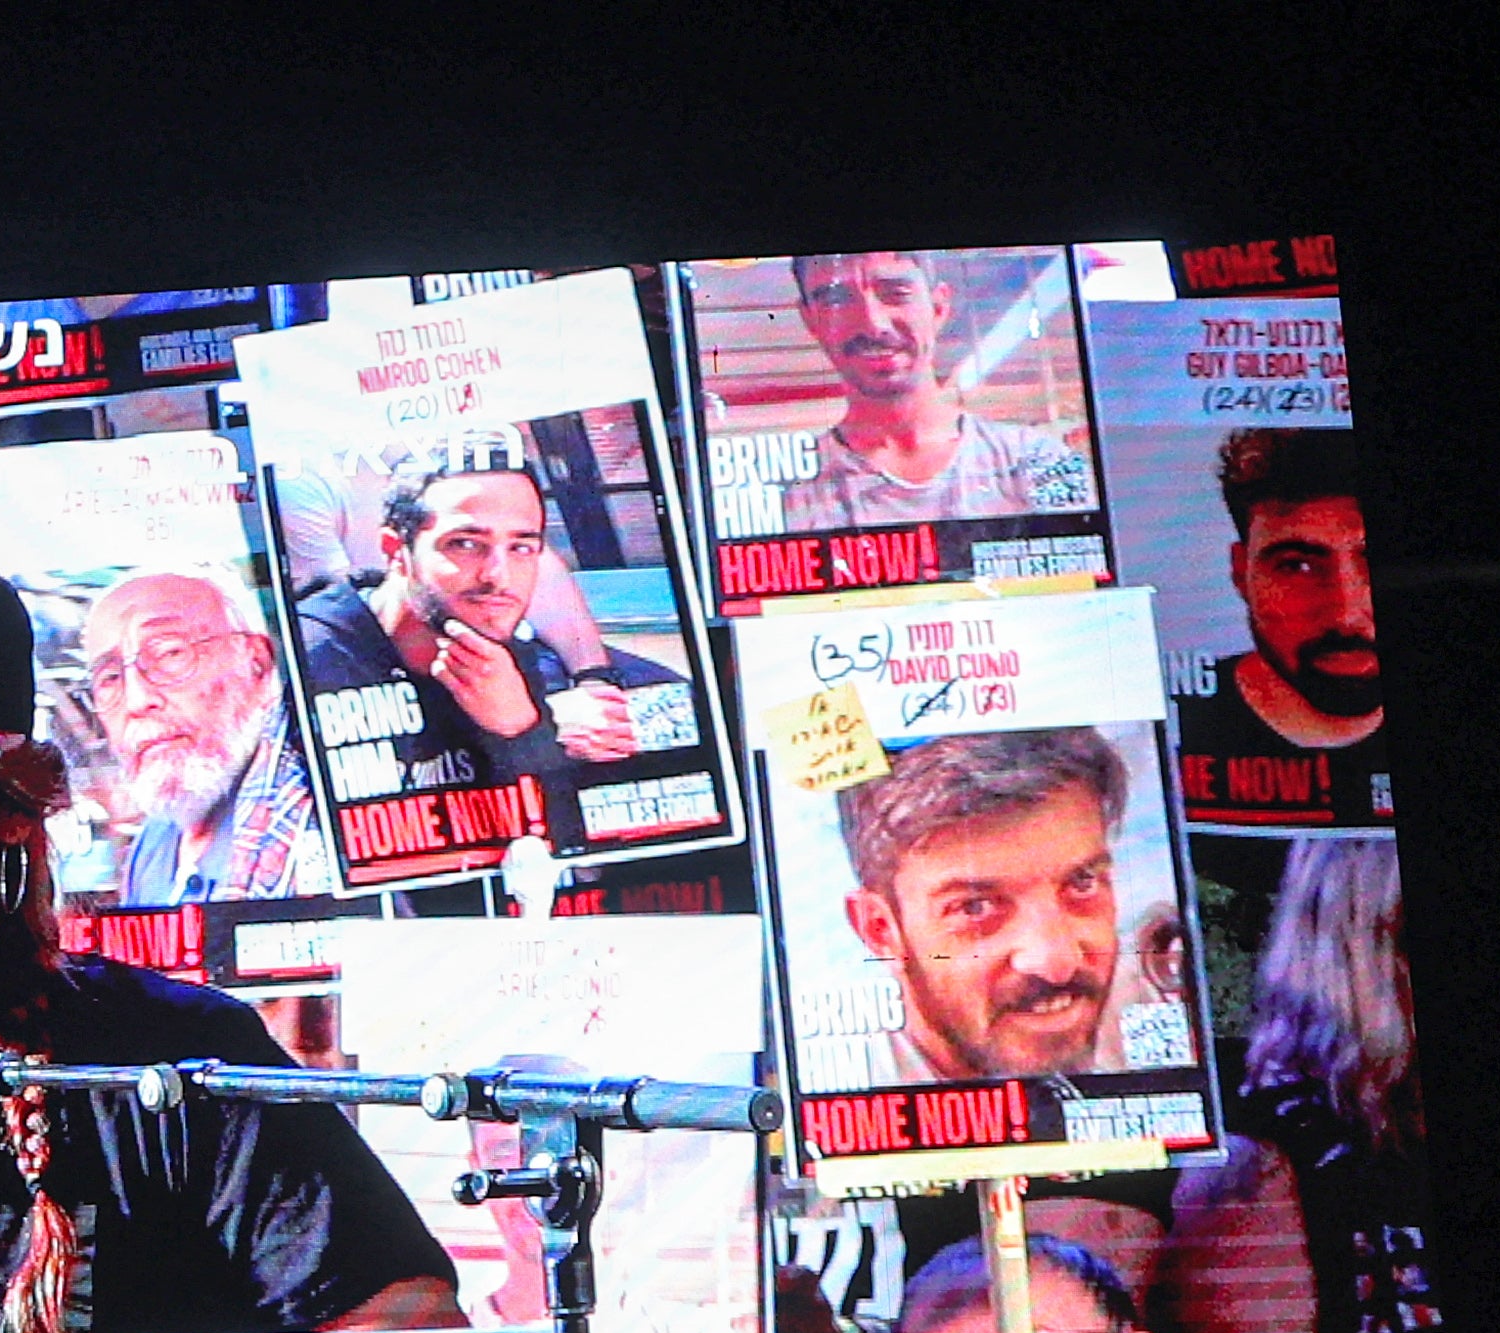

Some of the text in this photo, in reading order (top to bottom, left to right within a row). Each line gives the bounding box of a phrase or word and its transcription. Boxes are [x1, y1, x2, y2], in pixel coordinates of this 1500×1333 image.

[708, 431, 819, 484] BRING
[714, 488, 784, 536] HIM
[719, 525, 939, 595] HOME NOW!
[889, 656, 950, 684] DAVID
[315, 682, 424, 745] BRING
[327, 748, 401, 800] HIM
[340, 775, 547, 860] HOME NOW!
[799, 975, 905, 1037] BRING
[804, 1080, 1027, 1155] HOME NOW!
